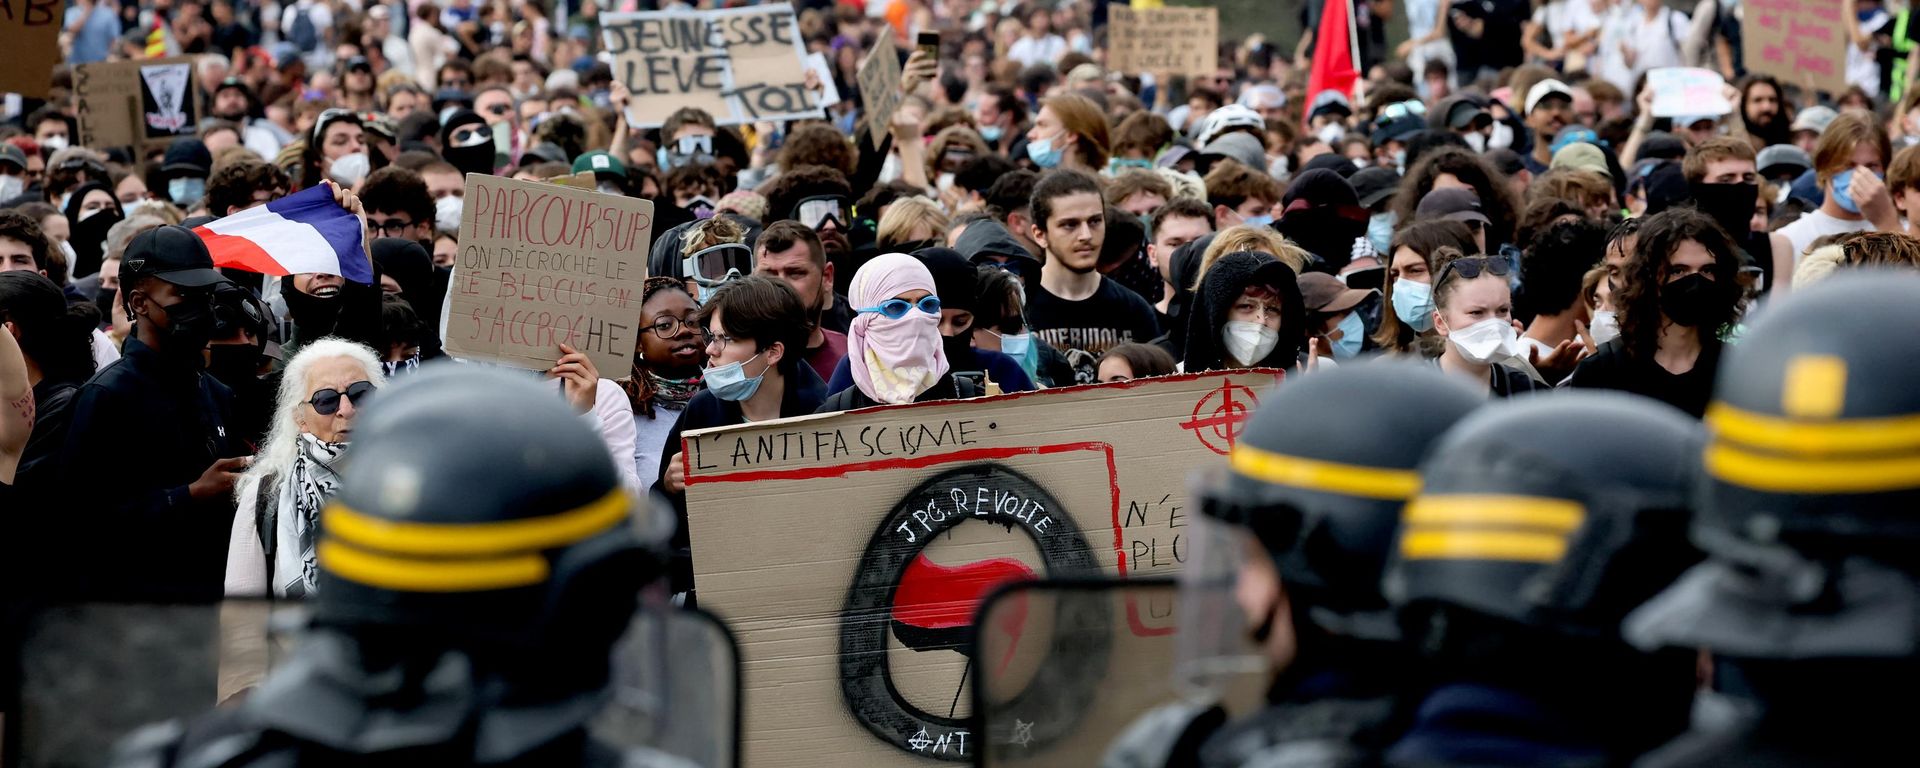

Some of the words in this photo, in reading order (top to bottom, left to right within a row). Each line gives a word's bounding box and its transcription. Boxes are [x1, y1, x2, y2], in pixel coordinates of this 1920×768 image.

[603, 12, 795, 54] JEUNESSE
[626, 55, 731, 95] LEVE
[720, 83, 819, 118] TOI
[473, 184, 651, 252] PARCOURSUP
[464, 245, 491, 270] ON
[605, 259, 628, 280] LE
[460, 271, 482, 295] LE
[496, 271, 597, 306] BLOCUS
[606, 286, 631, 309] ON
